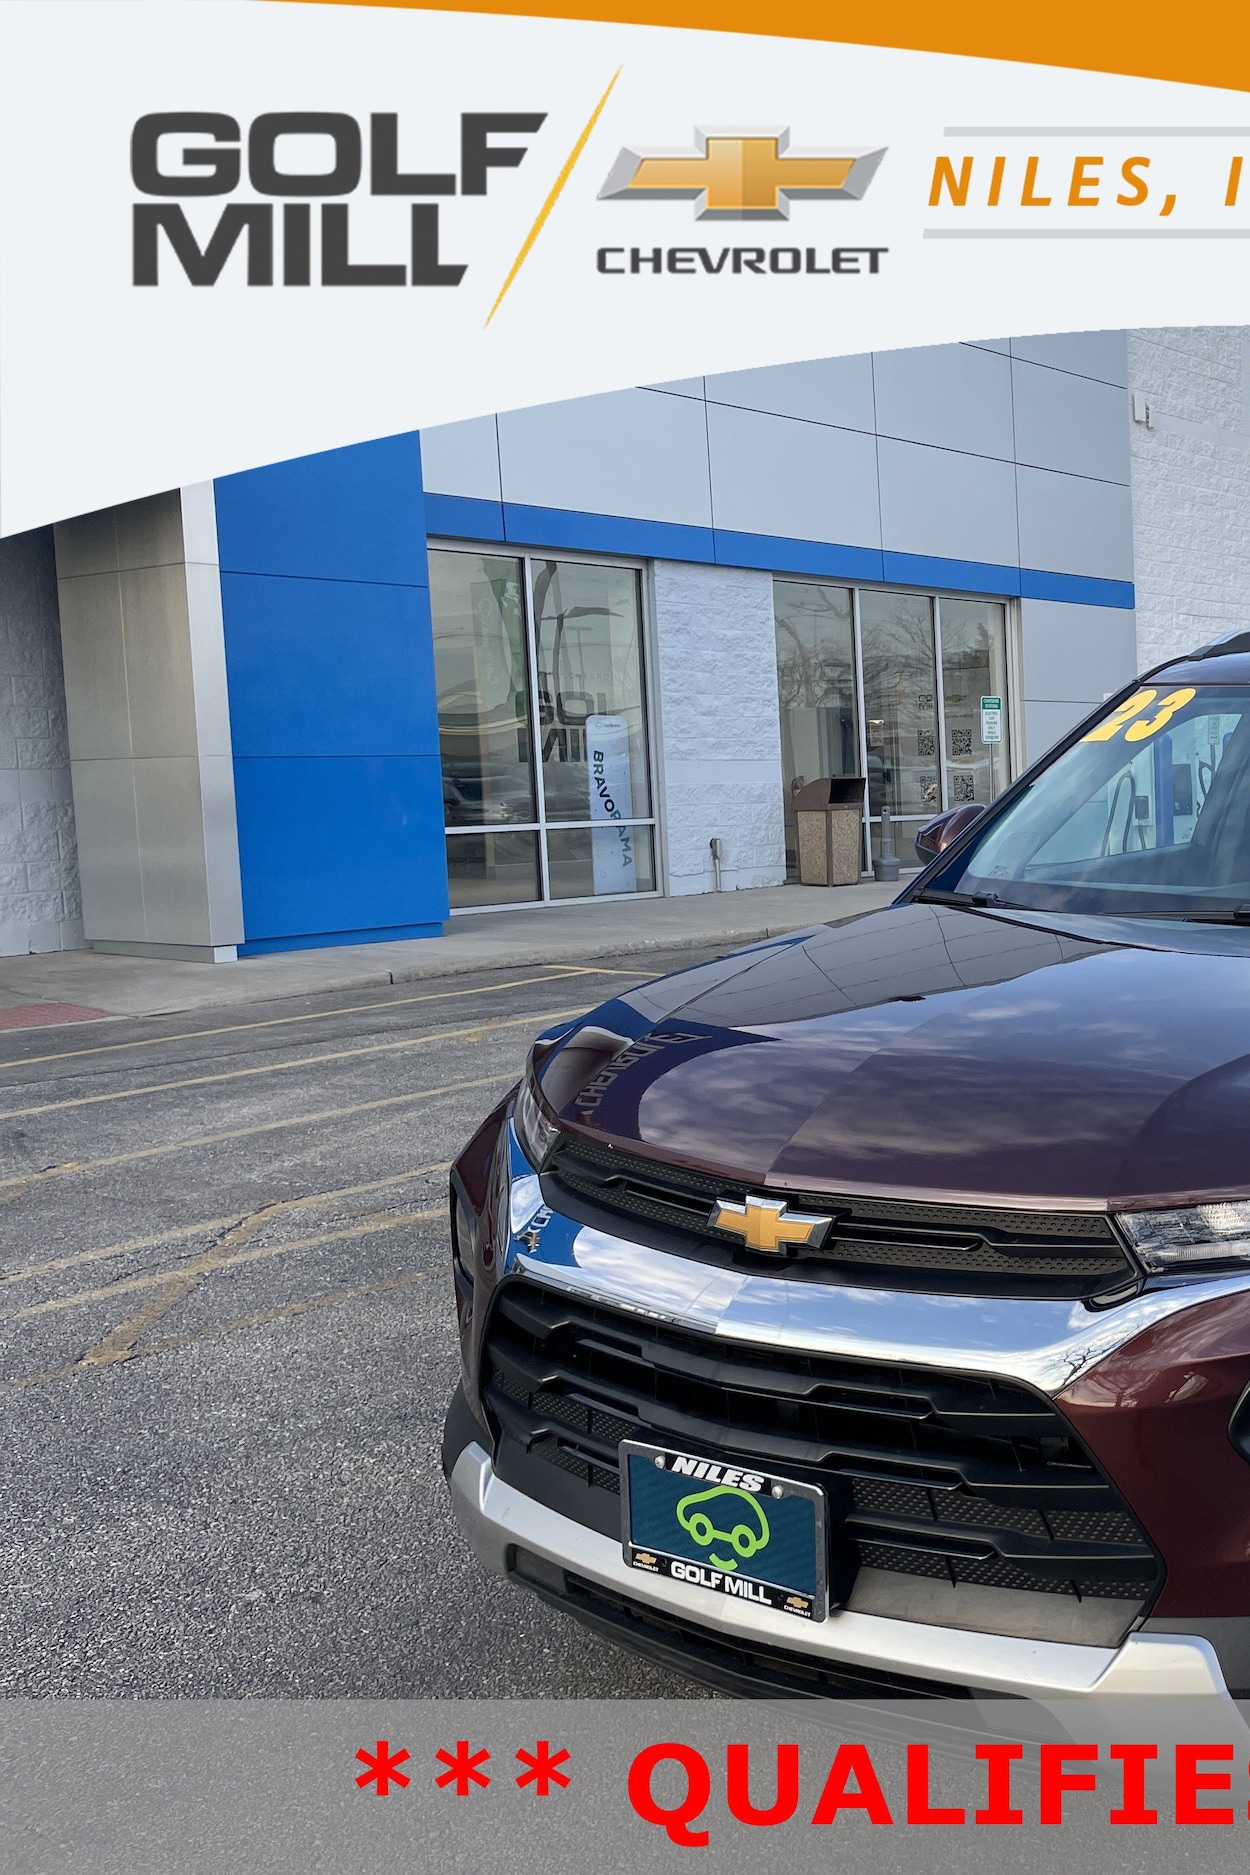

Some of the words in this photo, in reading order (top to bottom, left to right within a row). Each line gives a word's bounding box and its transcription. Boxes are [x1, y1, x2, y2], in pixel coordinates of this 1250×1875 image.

[1079, 687, 1197, 742] 23
[671, 1456, 765, 1493] NILES
[632, 1561, 660, 1573] CHEVROLET
[670, 1561, 722, 1589] GOLF
[724, 1575, 772, 1606] MILL
[783, 1604, 812, 1618] CHEVROLET
